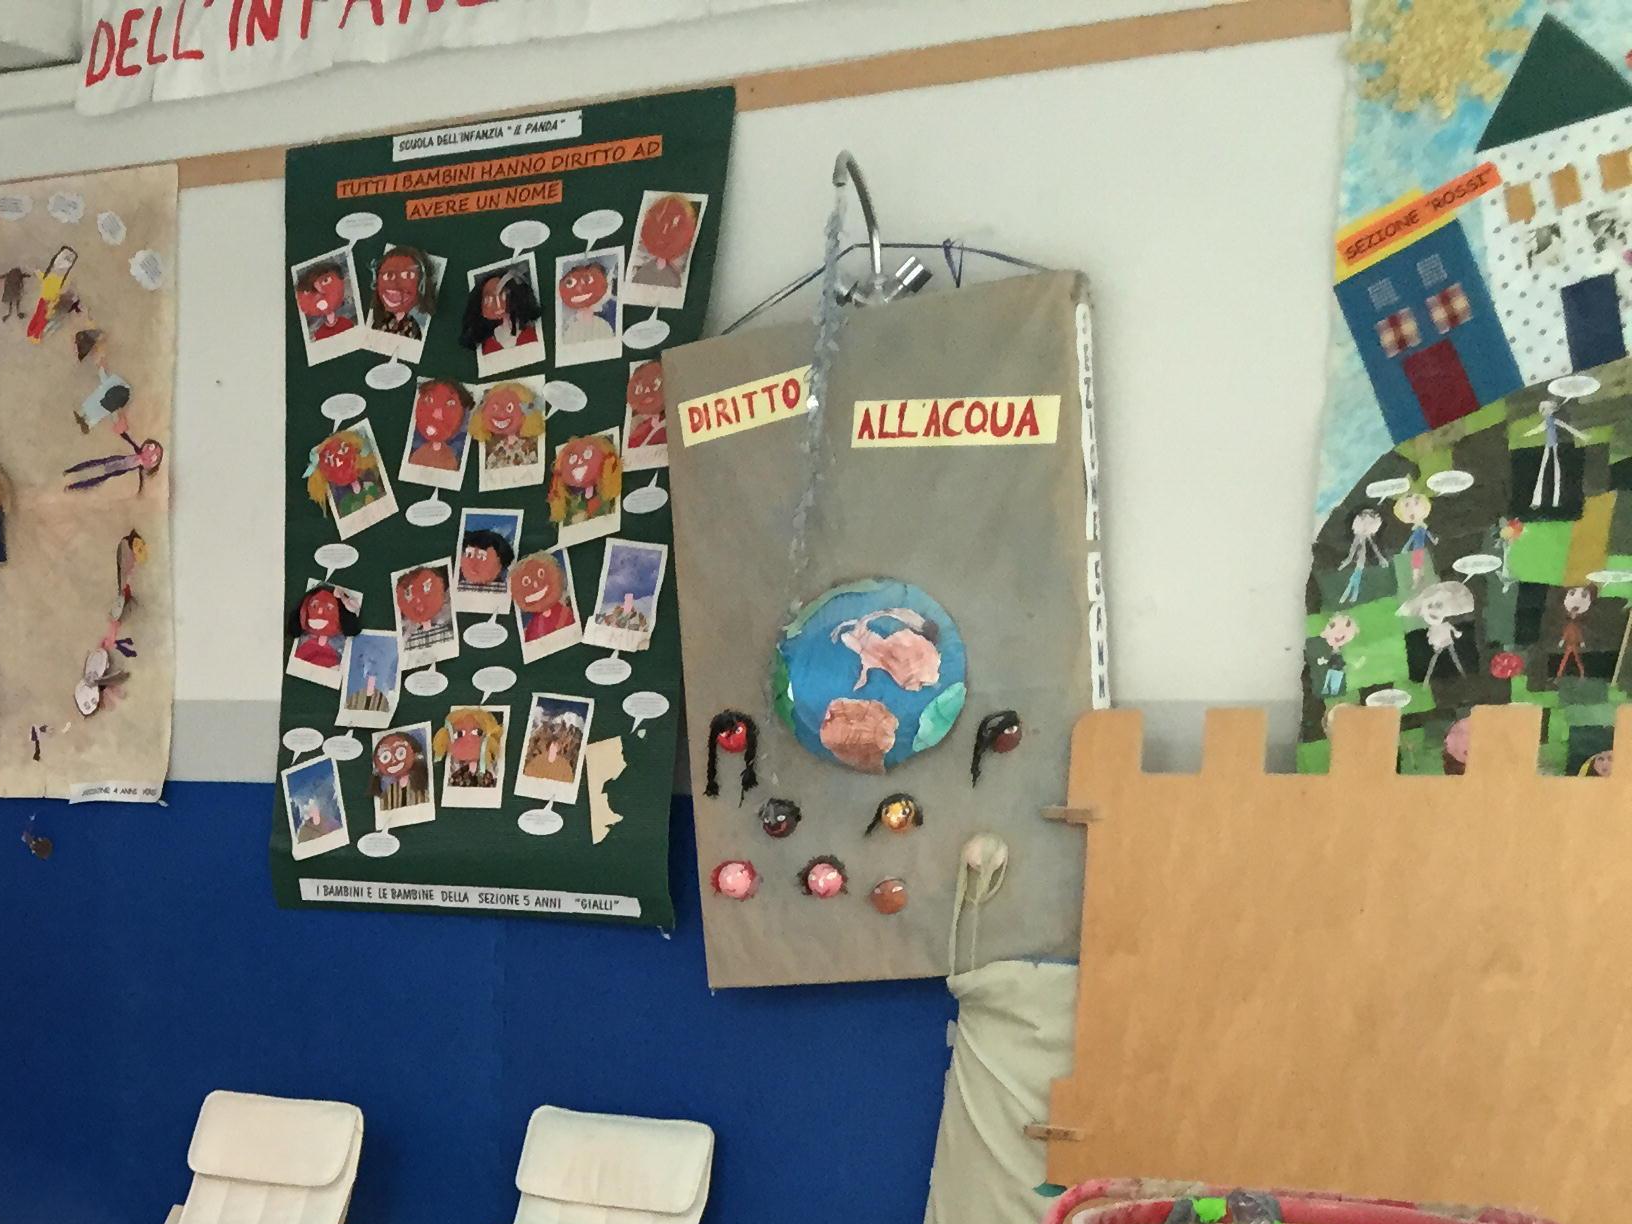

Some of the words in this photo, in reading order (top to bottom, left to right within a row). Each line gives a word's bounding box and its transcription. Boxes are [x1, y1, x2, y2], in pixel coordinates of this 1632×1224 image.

[399, 139, 433, 151] SCUOLA
[340, 179, 387, 196] TUTTI
[392, 177, 398, 192] I
[402, 166, 476, 190] BAMBINI
[481, 156, 545, 178] HANNO
[551, 146, 625, 170] DIRITTO
[633, 140, 660, 158] AD
[410, 200, 468, 219] AVERE
[475, 194, 505, 210] UN
[508, 183, 560, 206] NOME
[1345, 209, 1420, 260] SEZIONE
[688, 378, 801, 434] DIRITTO
[857, 397, 1041, 440] ALL'ACQUA
[316, 885, 320, 896] I
[323, 885, 364, 897] BAMBINI
[367, 887, 373, 898] E
[378, 888, 388, 899] LE
[391, 888, 434, 900] BAMBINE
[440, 890, 470, 903] DELLA
[478, 892, 520, 906] SEZIONE
[523, 895, 531, 906] 5
[534, 896, 562, 909] ANNI
[575, 898, 620, 910] "GIALLI"
